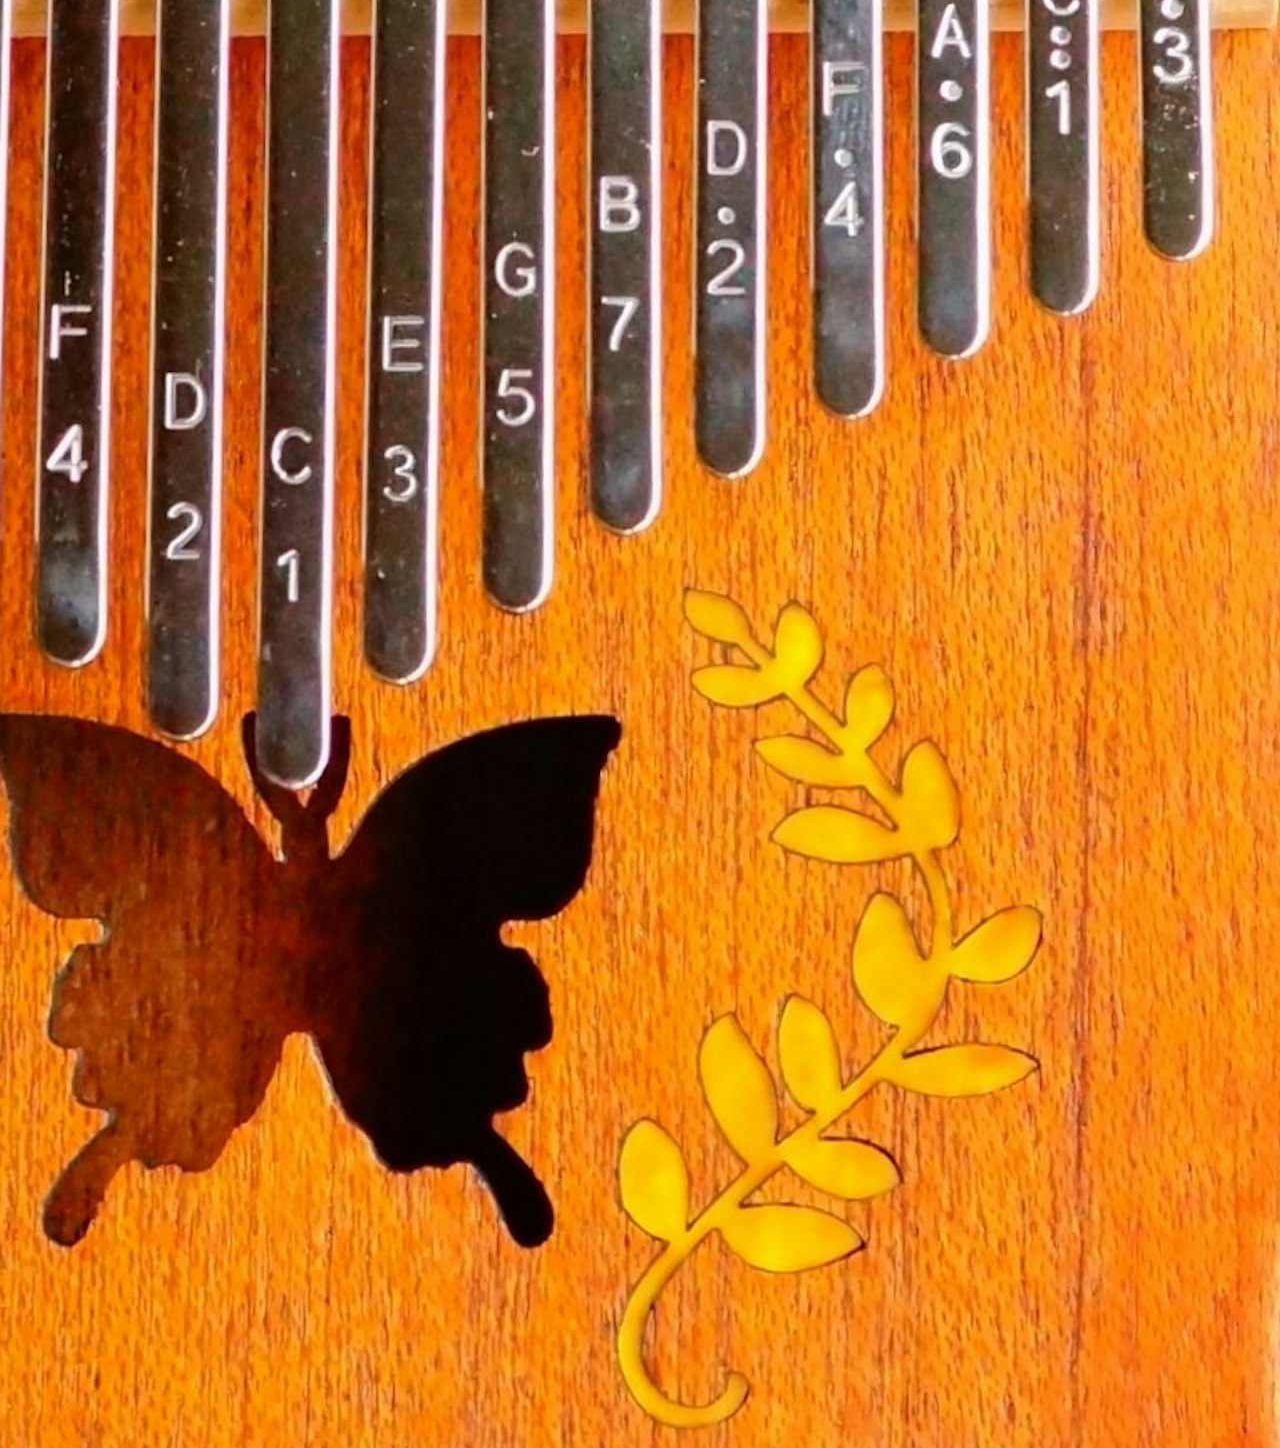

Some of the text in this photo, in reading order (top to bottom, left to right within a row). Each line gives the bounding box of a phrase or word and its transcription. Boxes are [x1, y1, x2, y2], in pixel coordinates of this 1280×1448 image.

[931, 4, 972, 59] A
[1152, 27, 1192, 83] 3
[822, 60, 864, 116] F
[1045, 81, 1071, 134] 1
[707, 120, 746, 175] D
[929, 123, 972, 178] 6
[600, 176, 640, 232] B
[824, 182, 864, 237] 4
[495, 242, 537, 297] G
[706, 239, 746, 296] 2
[48, 304, 92, 360] F
[382, 316, 425, 371] E
[600, 296, 639, 350] 7
[164, 373, 206, 429] D
[496, 369, 535, 426] 5
[46, 425, 88, 482] 4
[271, 427, 312, 484] C
[382, 445, 417, 501] 3
[165, 502, 203, 560] 2
[277, 549, 299, 602] 1
